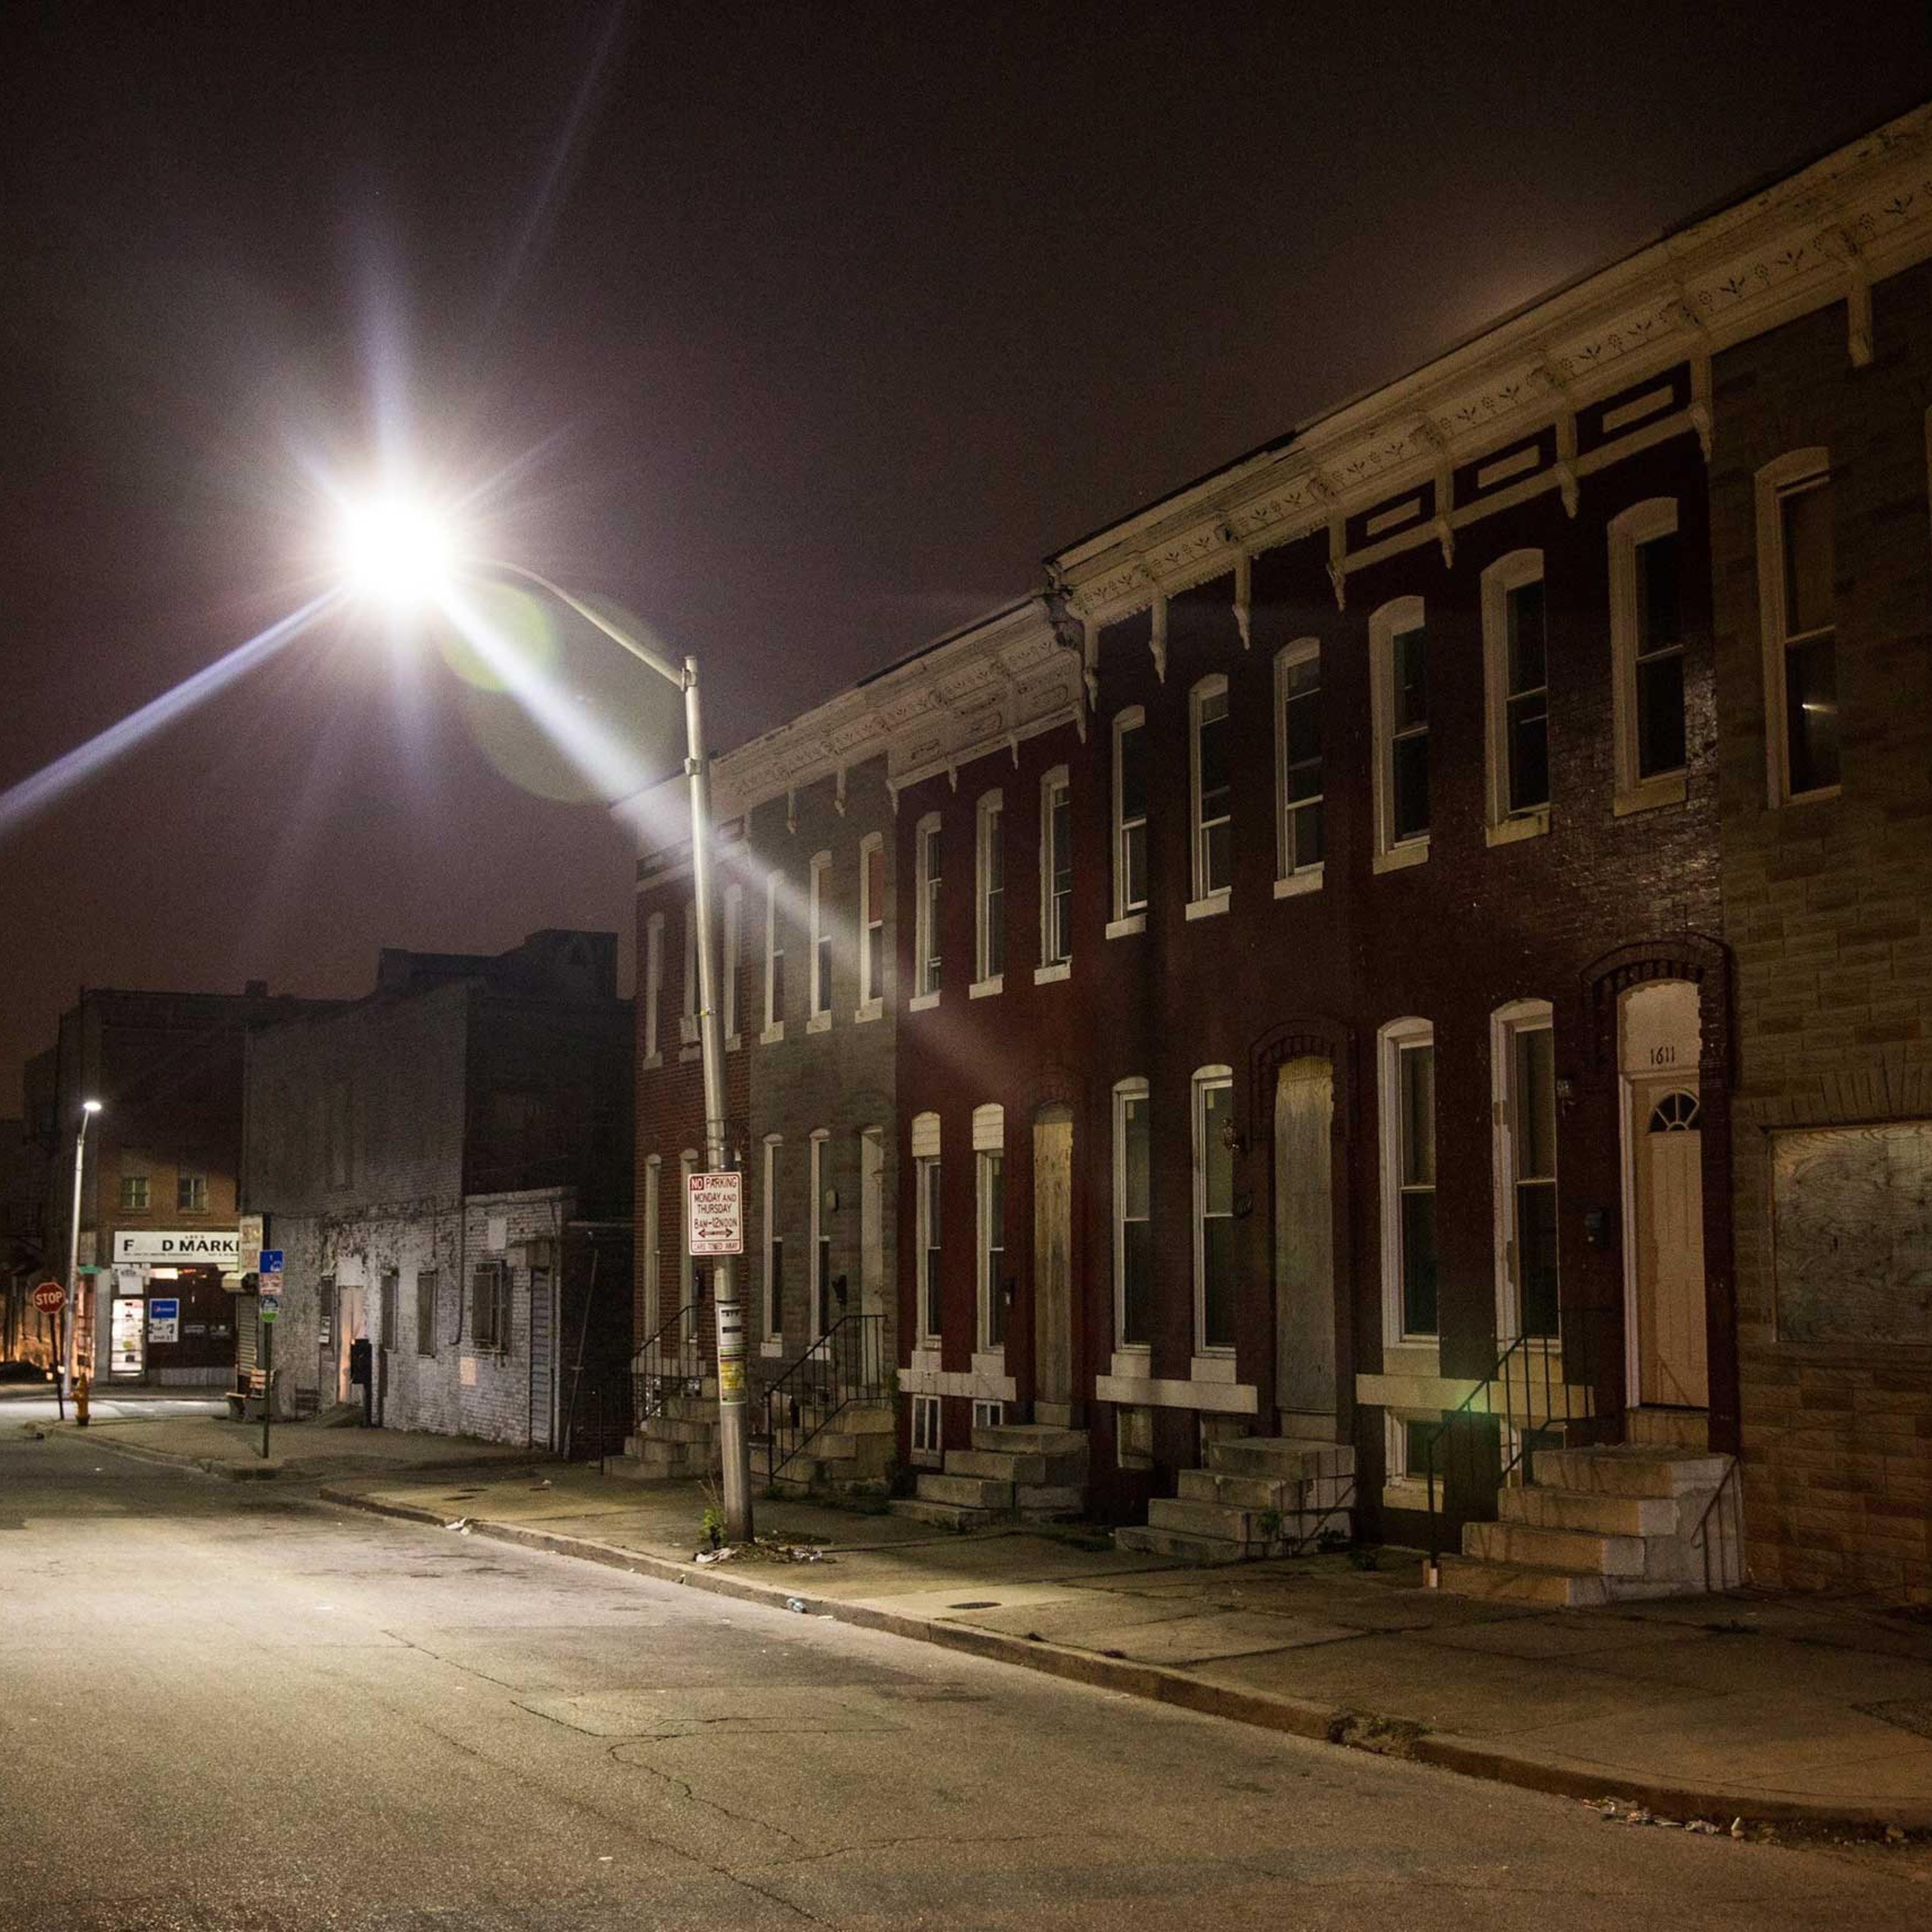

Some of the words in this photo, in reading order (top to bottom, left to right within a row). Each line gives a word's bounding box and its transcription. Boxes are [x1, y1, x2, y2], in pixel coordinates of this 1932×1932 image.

[1650, 1045, 1675, 1066] 1611
[691, 1177, 703, 1189] NO
[705, 1177, 737, 1188] PARKING
[694, 1192, 721, 1203] MONDAY
[722, 1194, 737, 1202] AND
[697, 1203, 732, 1214] THURSDAY
[179, 1240, 239, 1252] MARK
[36, 1291, 62, 1306] STOP
